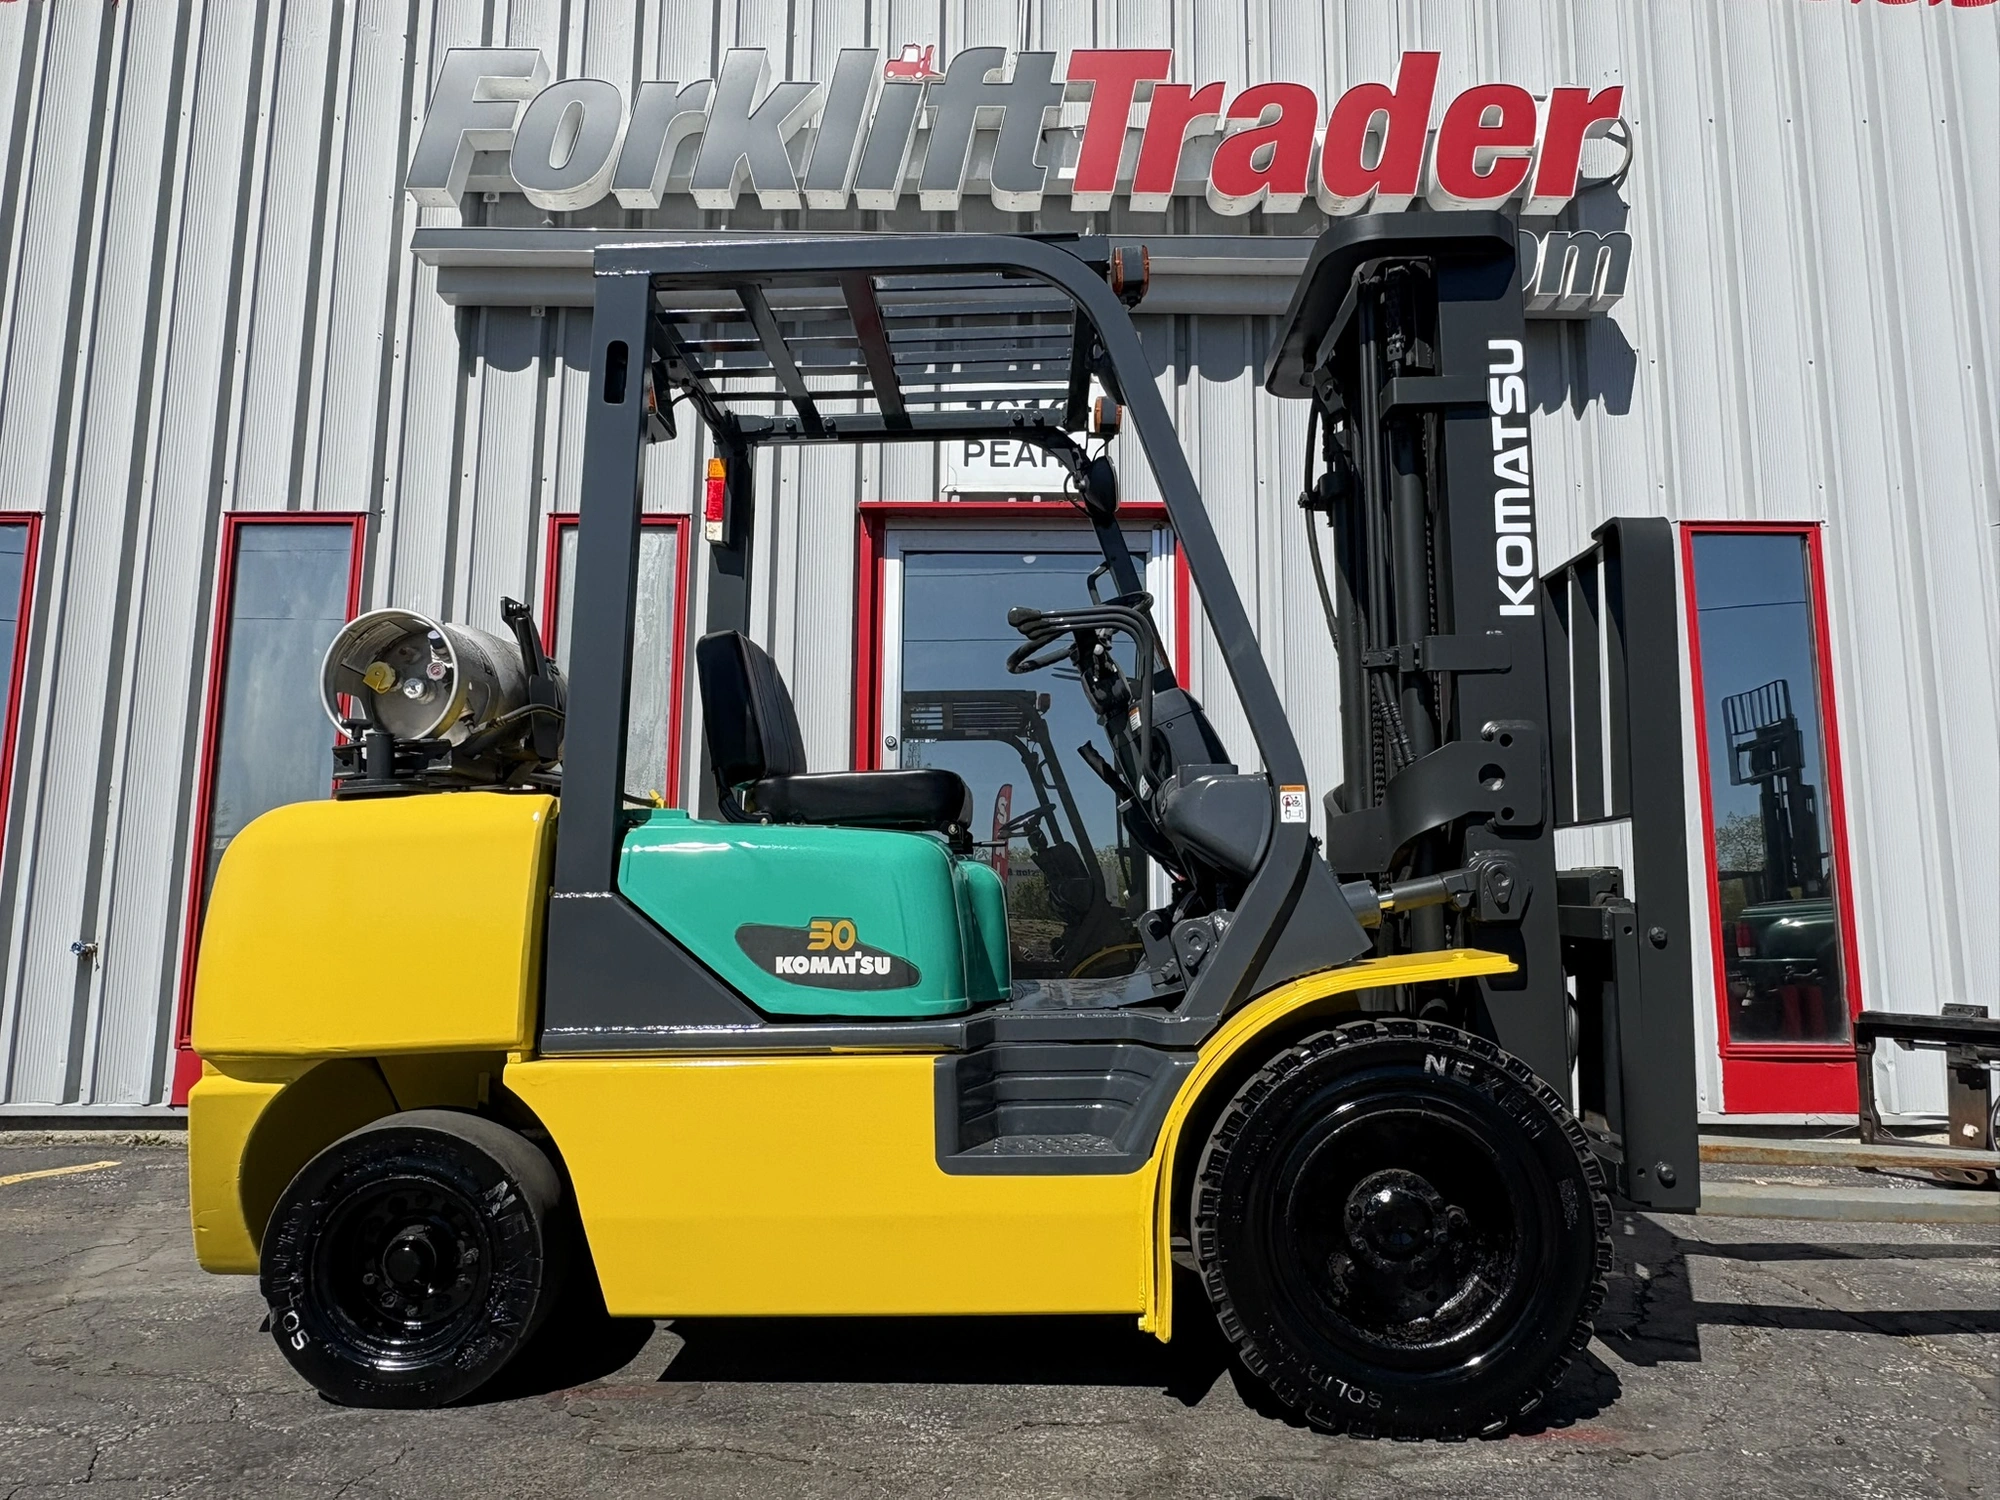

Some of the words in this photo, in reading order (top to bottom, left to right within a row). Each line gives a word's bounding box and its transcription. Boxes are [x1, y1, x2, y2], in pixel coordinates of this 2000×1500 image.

[1487, 339, 1536, 616] KOMATSU
[806, 919, 857, 951] 30
[775, 951, 891, 975] KOMATSU
